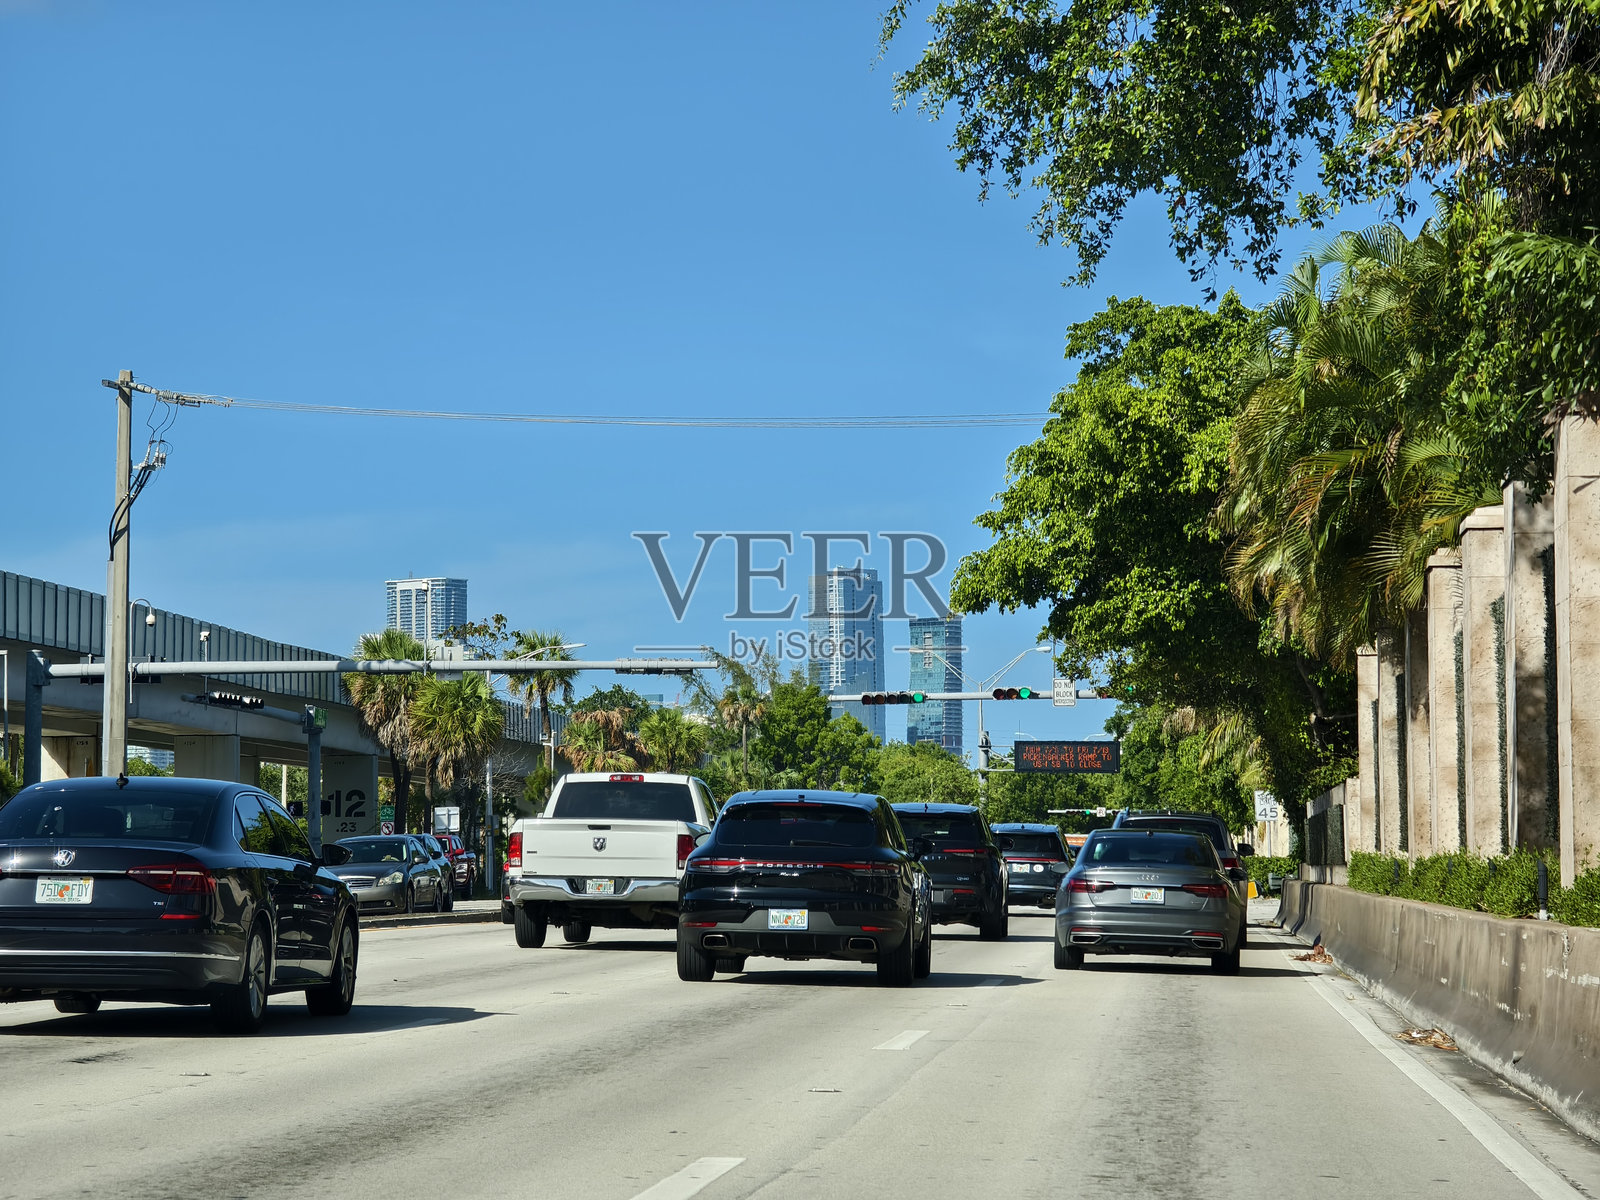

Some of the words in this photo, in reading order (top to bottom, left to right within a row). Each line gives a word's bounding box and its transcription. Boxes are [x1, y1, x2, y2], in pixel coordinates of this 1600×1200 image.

[1078, 753, 1098, 761] RAMP
[1101, 753, 1112, 761] TO
[1065, 760, 1075, 768] TO
[1079, 760, 1102, 768] CLOSE
[328, 790, 366, 817] 12
[1259, 808, 1278, 818] 45
